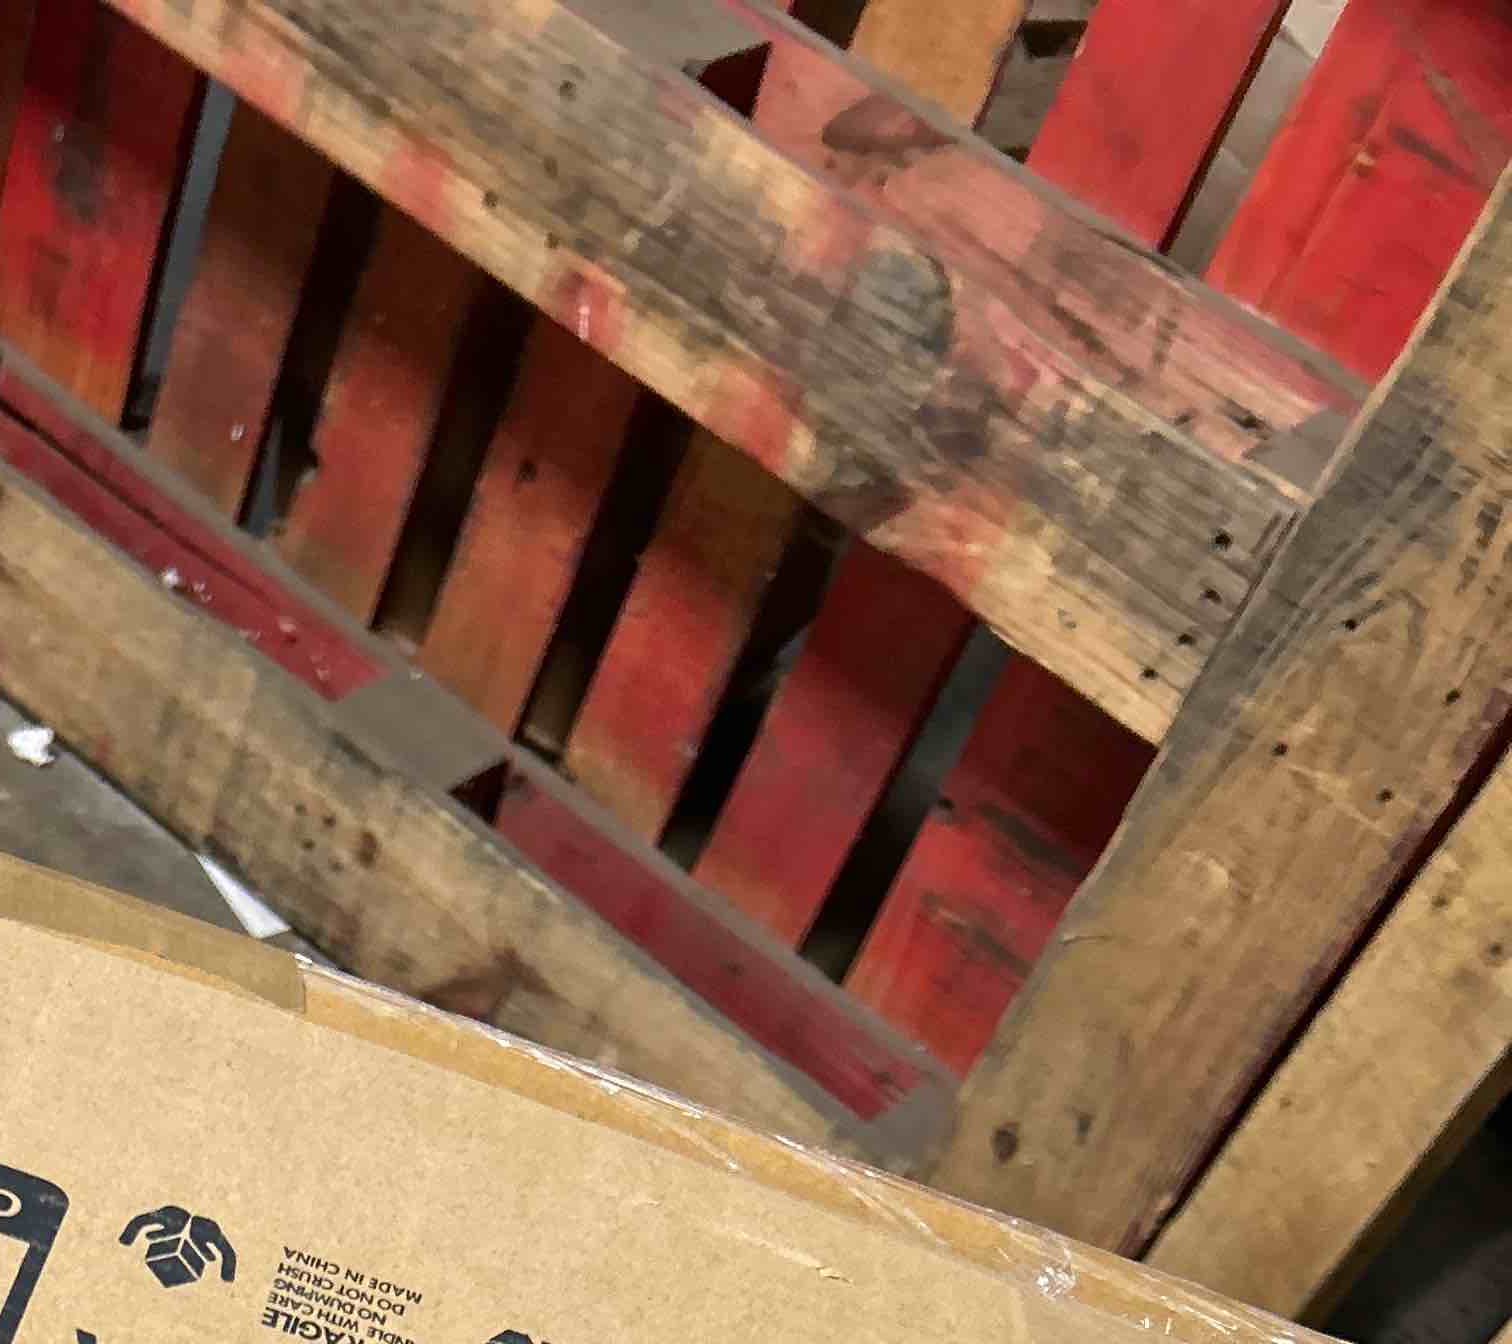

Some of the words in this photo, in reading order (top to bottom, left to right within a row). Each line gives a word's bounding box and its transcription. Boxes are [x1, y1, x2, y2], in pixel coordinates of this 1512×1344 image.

[283, 1246, 340, 1276] CHINA
[277, 1262, 334, 1291] CRUSH
[344, 1268, 364, 1285] IN
[273, 1277, 355, 1315] DUMPING
[336, 1284, 374, 1305] NOT
[368, 1276, 423, 1304] MADE
[268, 1291, 314, 1315] CARE
[377, 1298, 405, 1316] DO
[317, 1307, 359, 1333] WITH
[357, 1307, 387, 1326] NO
